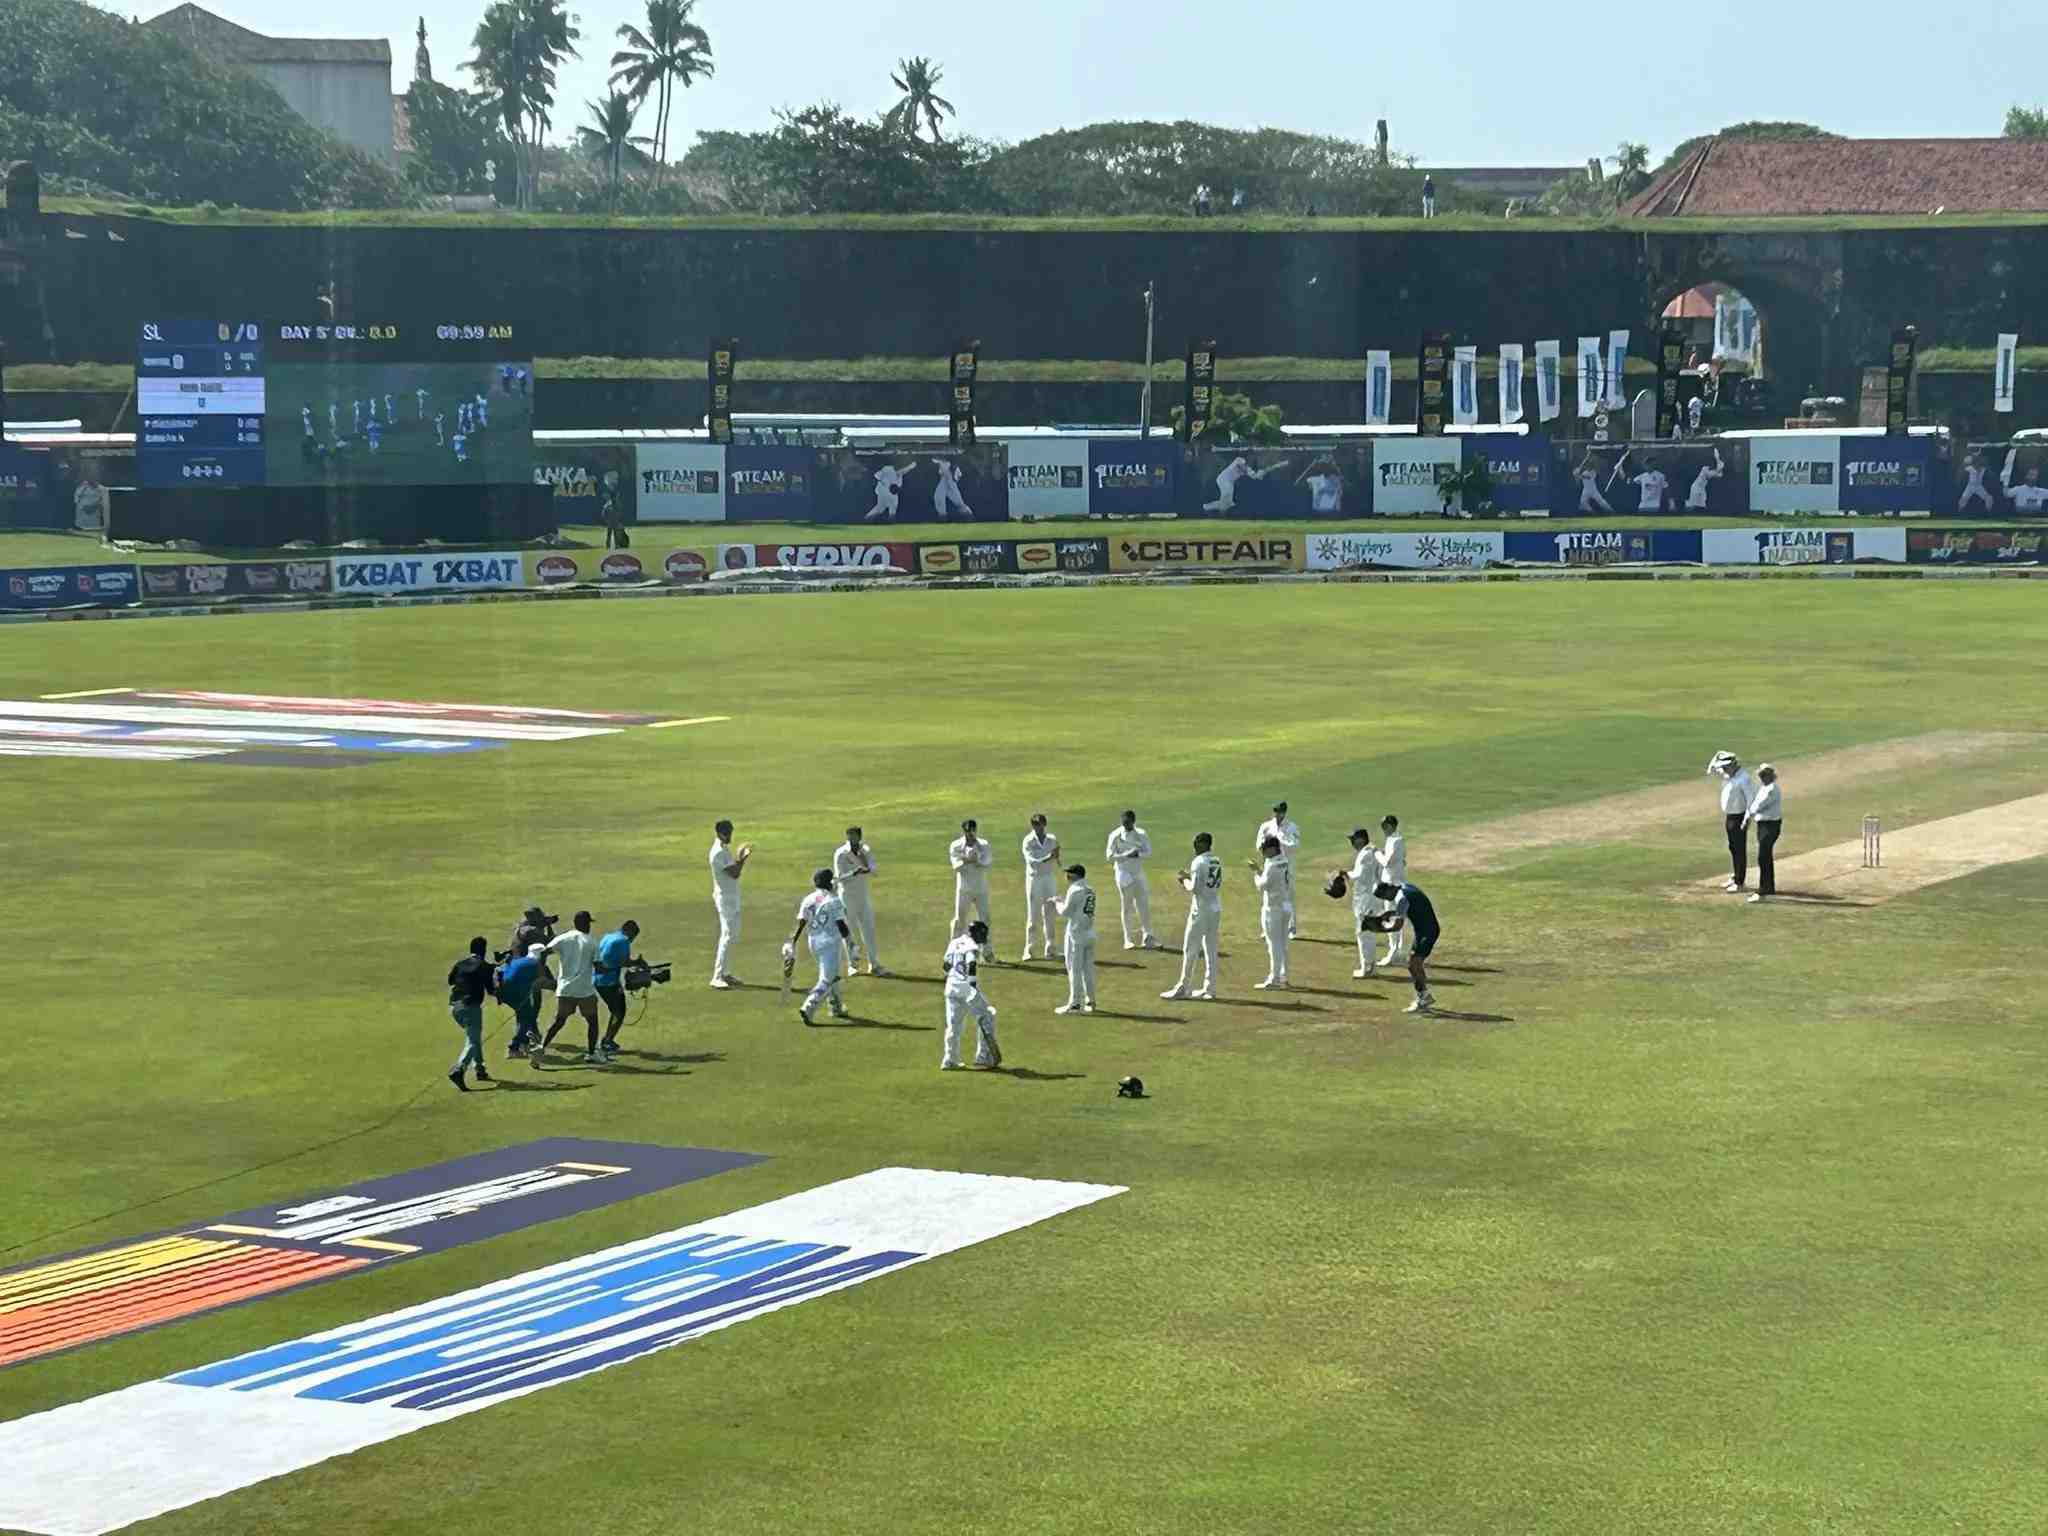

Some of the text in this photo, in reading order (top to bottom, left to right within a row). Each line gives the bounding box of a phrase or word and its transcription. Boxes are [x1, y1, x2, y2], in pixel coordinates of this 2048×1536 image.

[143, 324, 165, 341] SL
[281, 326, 311, 339] DAY
[1488, 460, 1520, 473] EAM
[1139, 540, 1292, 561] CBTFAIR
[1441, 535, 1493, 555] Hayleys
[777, 545, 891, 567] SERVO
[337, 562, 423, 587] 1XBAT
[433, 558, 518, 584] 1XBAT
